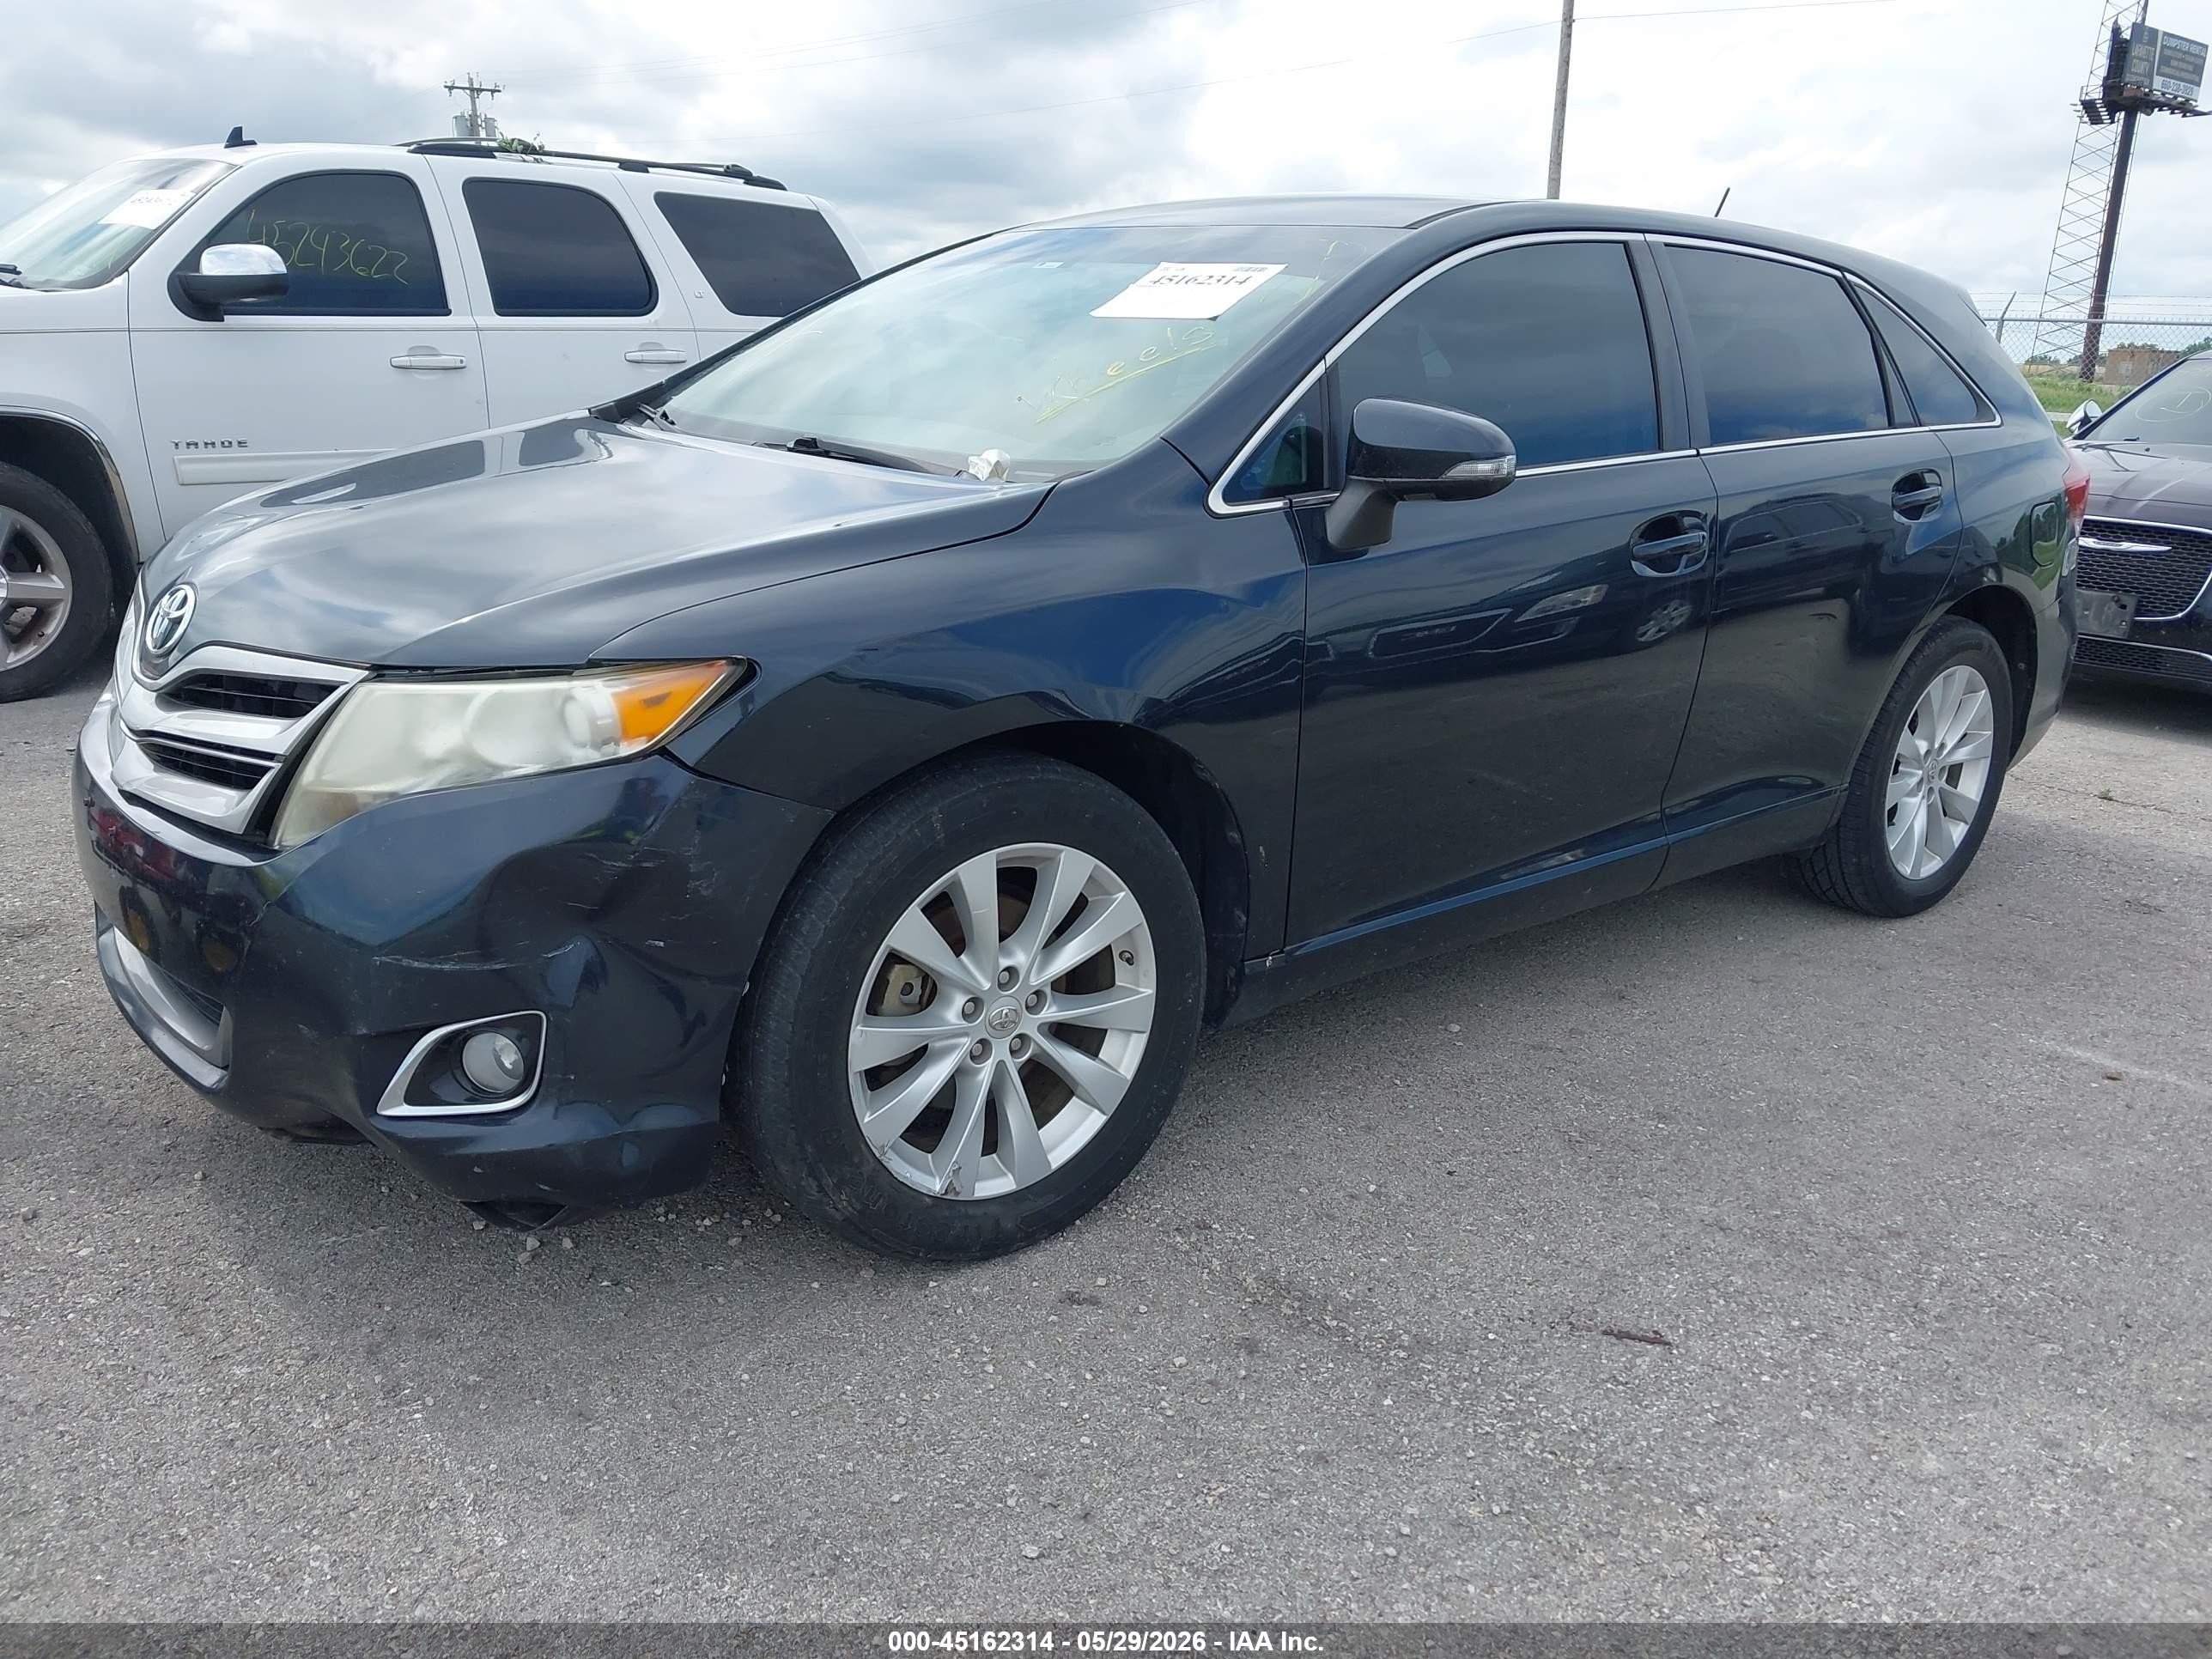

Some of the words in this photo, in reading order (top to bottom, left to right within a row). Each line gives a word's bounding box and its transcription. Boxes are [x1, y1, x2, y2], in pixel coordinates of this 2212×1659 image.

[246, 209, 410, 286] 45243622
[1149, 275, 1253, 285] 45162314
[169, 438, 249, 450] TAHOE
